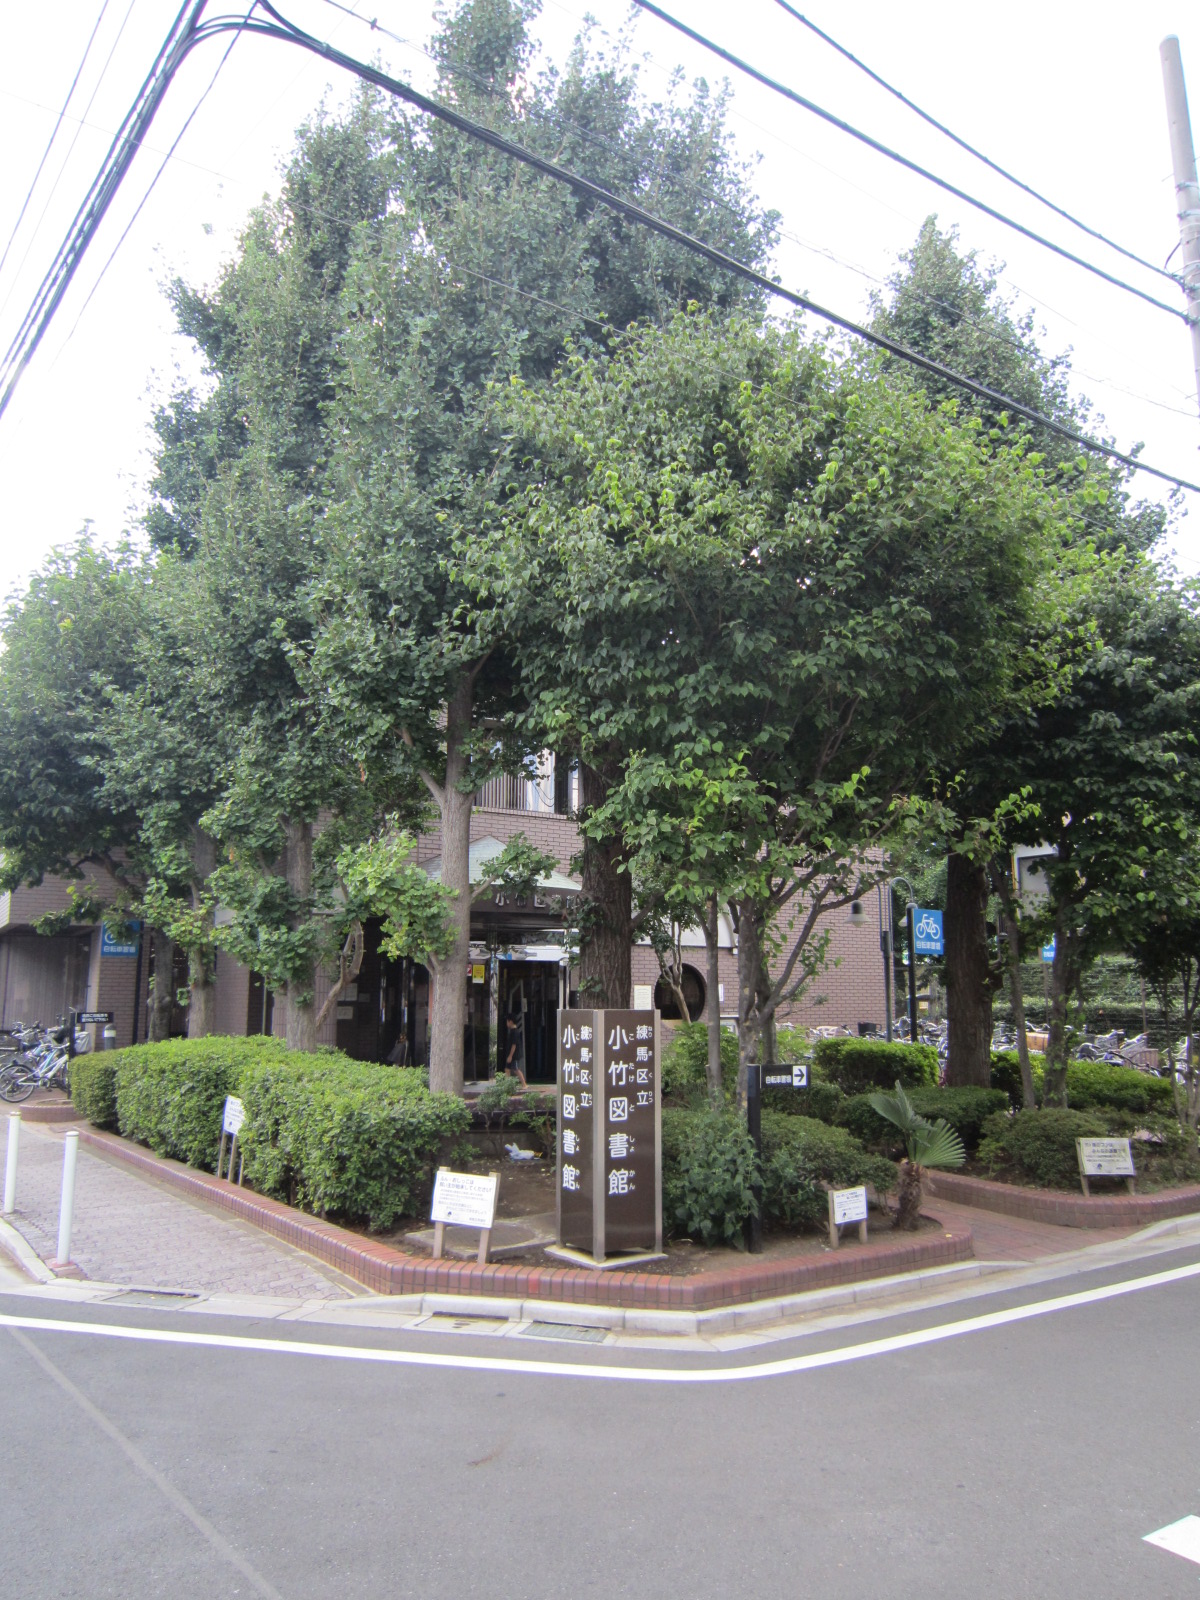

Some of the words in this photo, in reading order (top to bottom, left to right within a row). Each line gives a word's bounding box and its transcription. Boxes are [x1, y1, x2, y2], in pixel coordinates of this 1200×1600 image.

[563, 1024, 576, 1191] 小竹図書館
[580, 1025, 590, 1107] 練馬区立
[608, 1025, 629, 1195] 小竹図書館
[636, 1024, 649, 1106] 練馬区立
